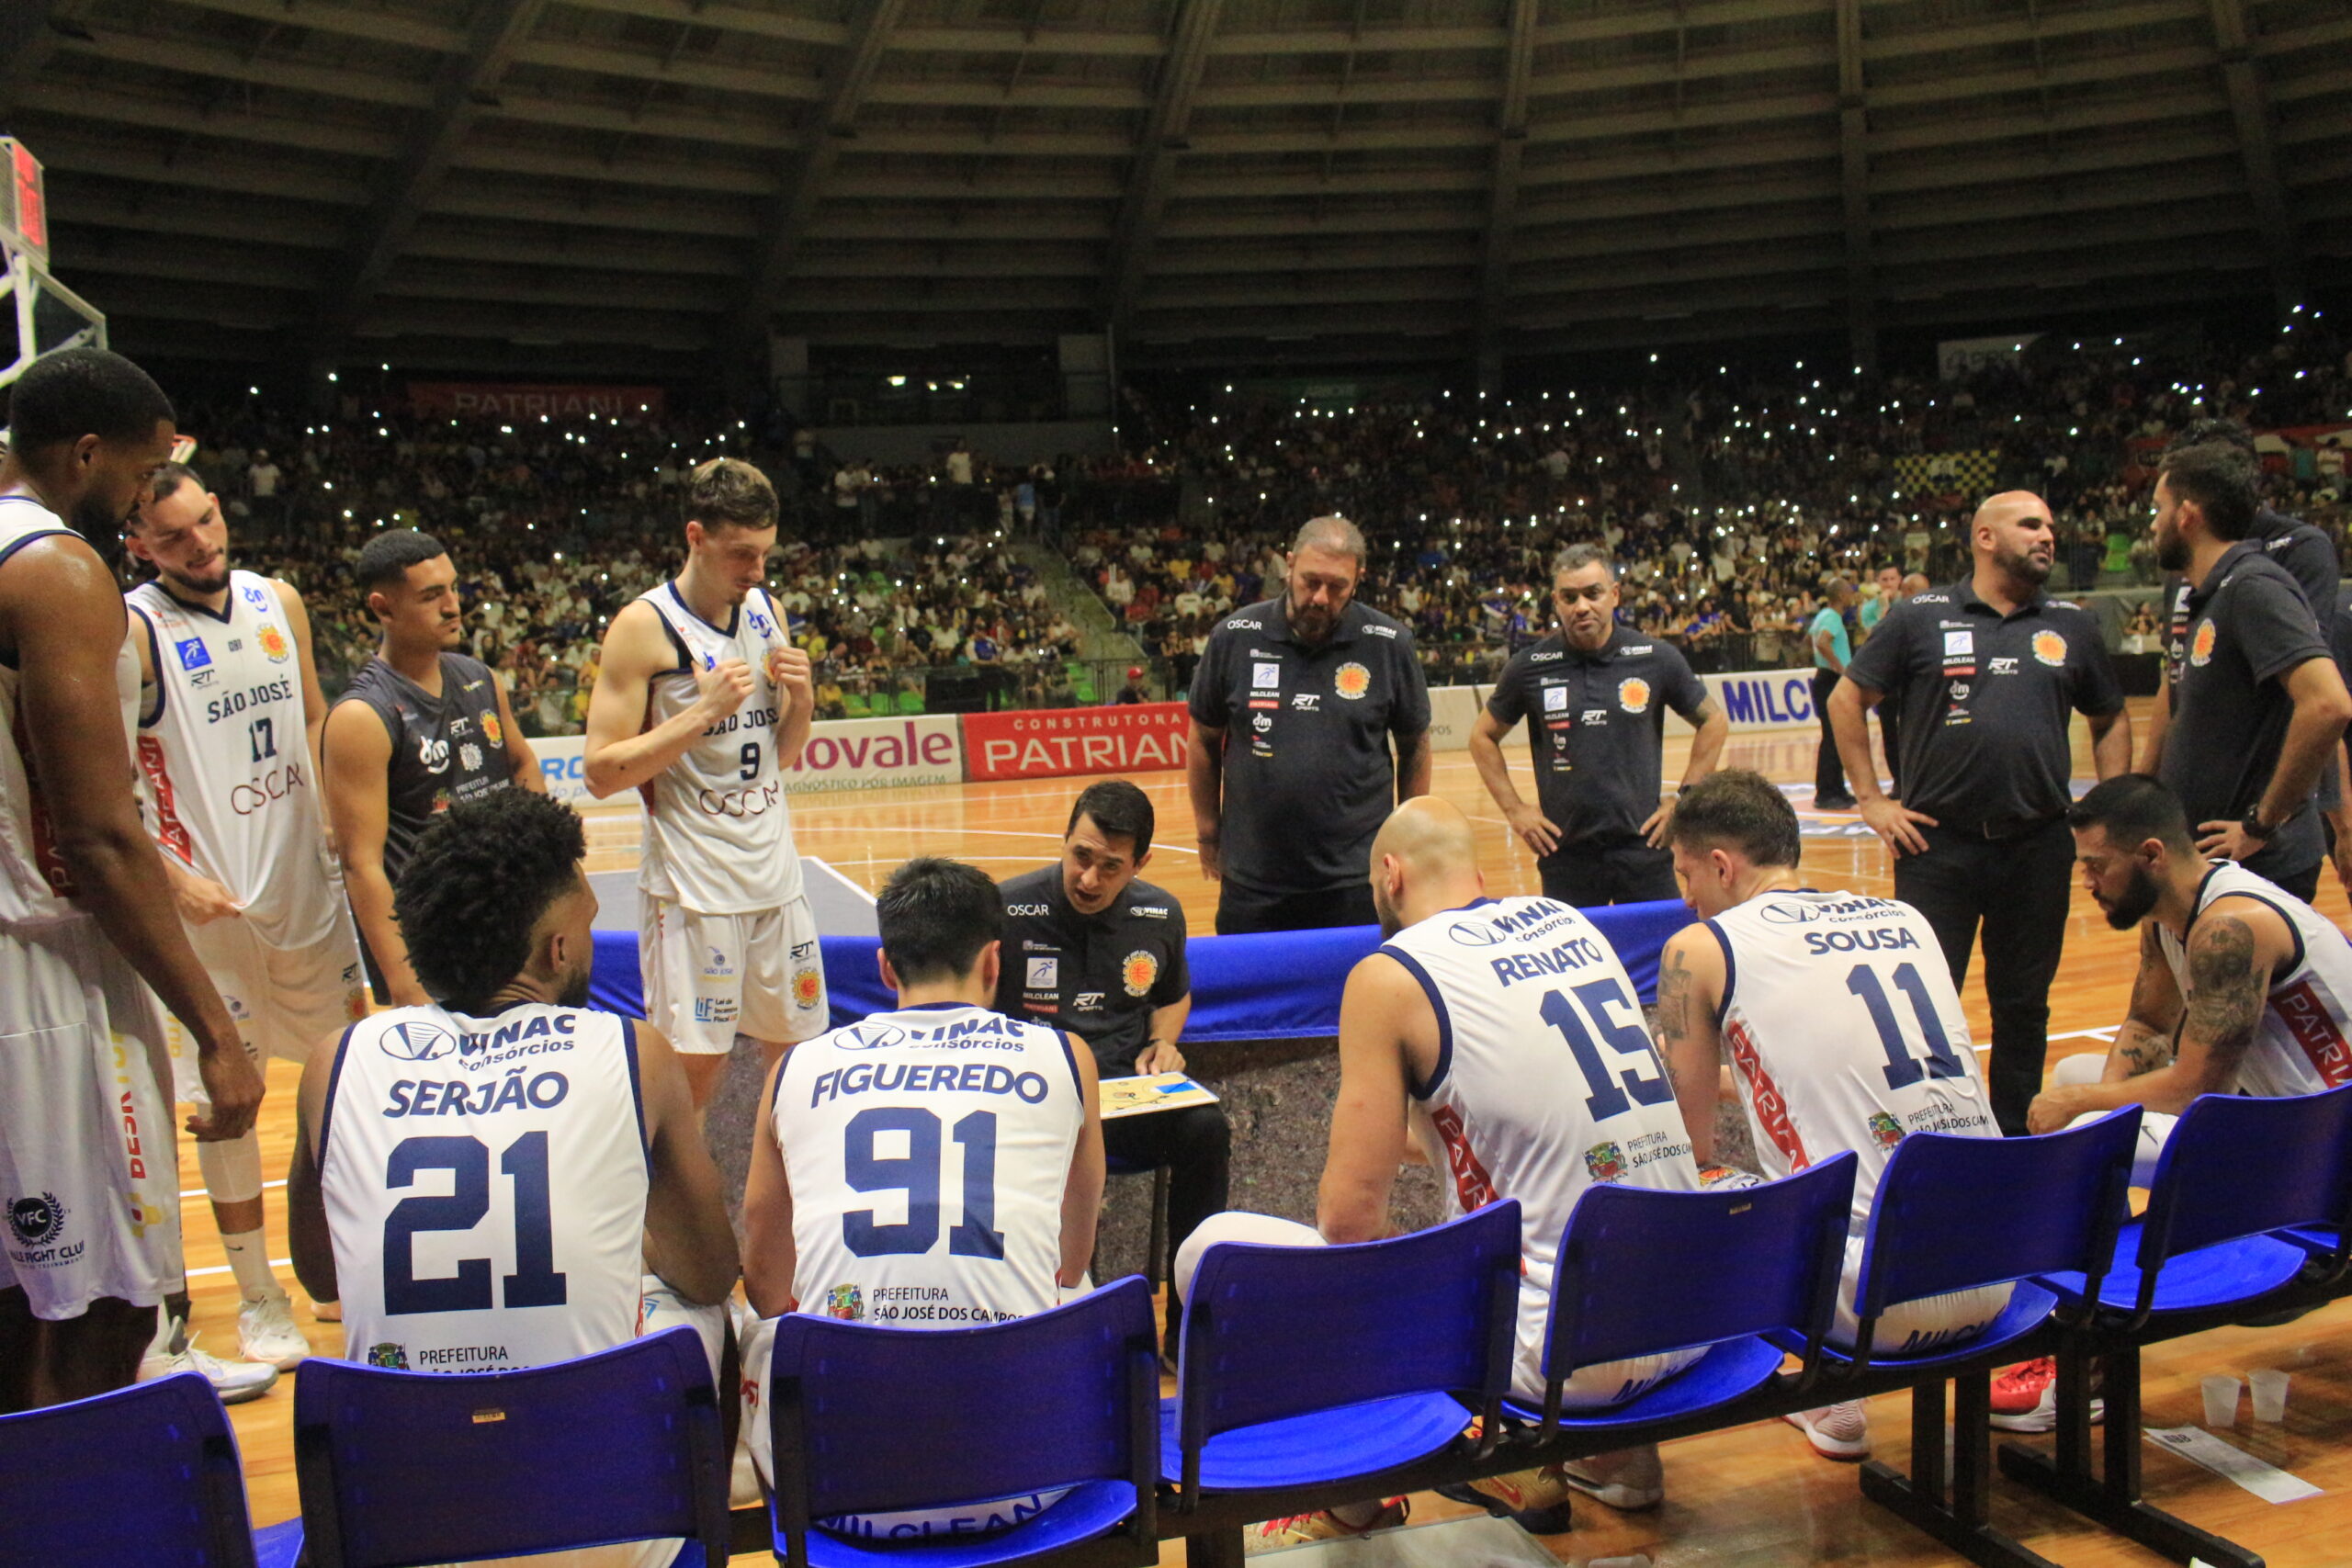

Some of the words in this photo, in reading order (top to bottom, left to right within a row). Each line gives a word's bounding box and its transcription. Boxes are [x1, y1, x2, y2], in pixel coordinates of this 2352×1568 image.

[455, 393, 622, 414] PATRIANI
[1913, 594, 1950, 604] OSCAR
[1227, 619, 1262, 630] OSCAR
[1531, 651, 1563, 661] OSCAR
[1988, 658, 2018, 670] RT
[208, 691, 246, 723] SÃO
[250, 674, 293, 706] JOSÉ
[1292, 694, 1320, 706] RT
[1723, 677, 1820, 723] MILC
[743, 708, 779, 728] JOS
[1014, 713, 1182, 730] CONSTRUTORA
[1581, 710, 1607, 722] RT
[249, 717, 277, 762] 17
[793, 721, 953, 772] ovale
[741, 742, 760, 780] 9
[862, 778, 887, 789] POR
[891, 774, 946, 788] IMAGEM
[1007, 904, 1049, 916] OSCAR
[1804, 927, 1920, 954] SOUSA
[790, 941, 813, 959] RT
[1490, 937, 1604, 987] RENATO
[1023, 992, 1059, 1000] MILCLEAN
[1073, 993, 1105, 1006] RT
[459, 1014, 576, 1056] VINAC
[911, 1017, 1024, 1041] VINAC
[1846, 963, 1966, 1090] 11
[909, 1036, 1024, 1052] sórcios
[1539, 977, 1675, 1122] 15
[458, 1040, 574, 1071] consórcios
[382, 1066, 570, 1118] SERJÃO
[810, 1063, 1048, 1109] FIGUEREDO
[1951, 1117, 1971, 1129] DOS
[1663, 1145, 1680, 1157] DOS
[842, 1107, 1005, 1260] 91
[17, 1209, 46, 1224] VFC
[383, 1131, 567, 1315] 21
[26, 1249, 55, 1263] FIGHT
[873, 1288, 949, 1301] PREFEITURA
[875, 1304, 899, 1321] SÃO
[901, 1304, 935, 1320] JOSÉ
[938, 1307, 967, 1320] DOS
[420, 1346, 508, 1365] PREFEITURA
